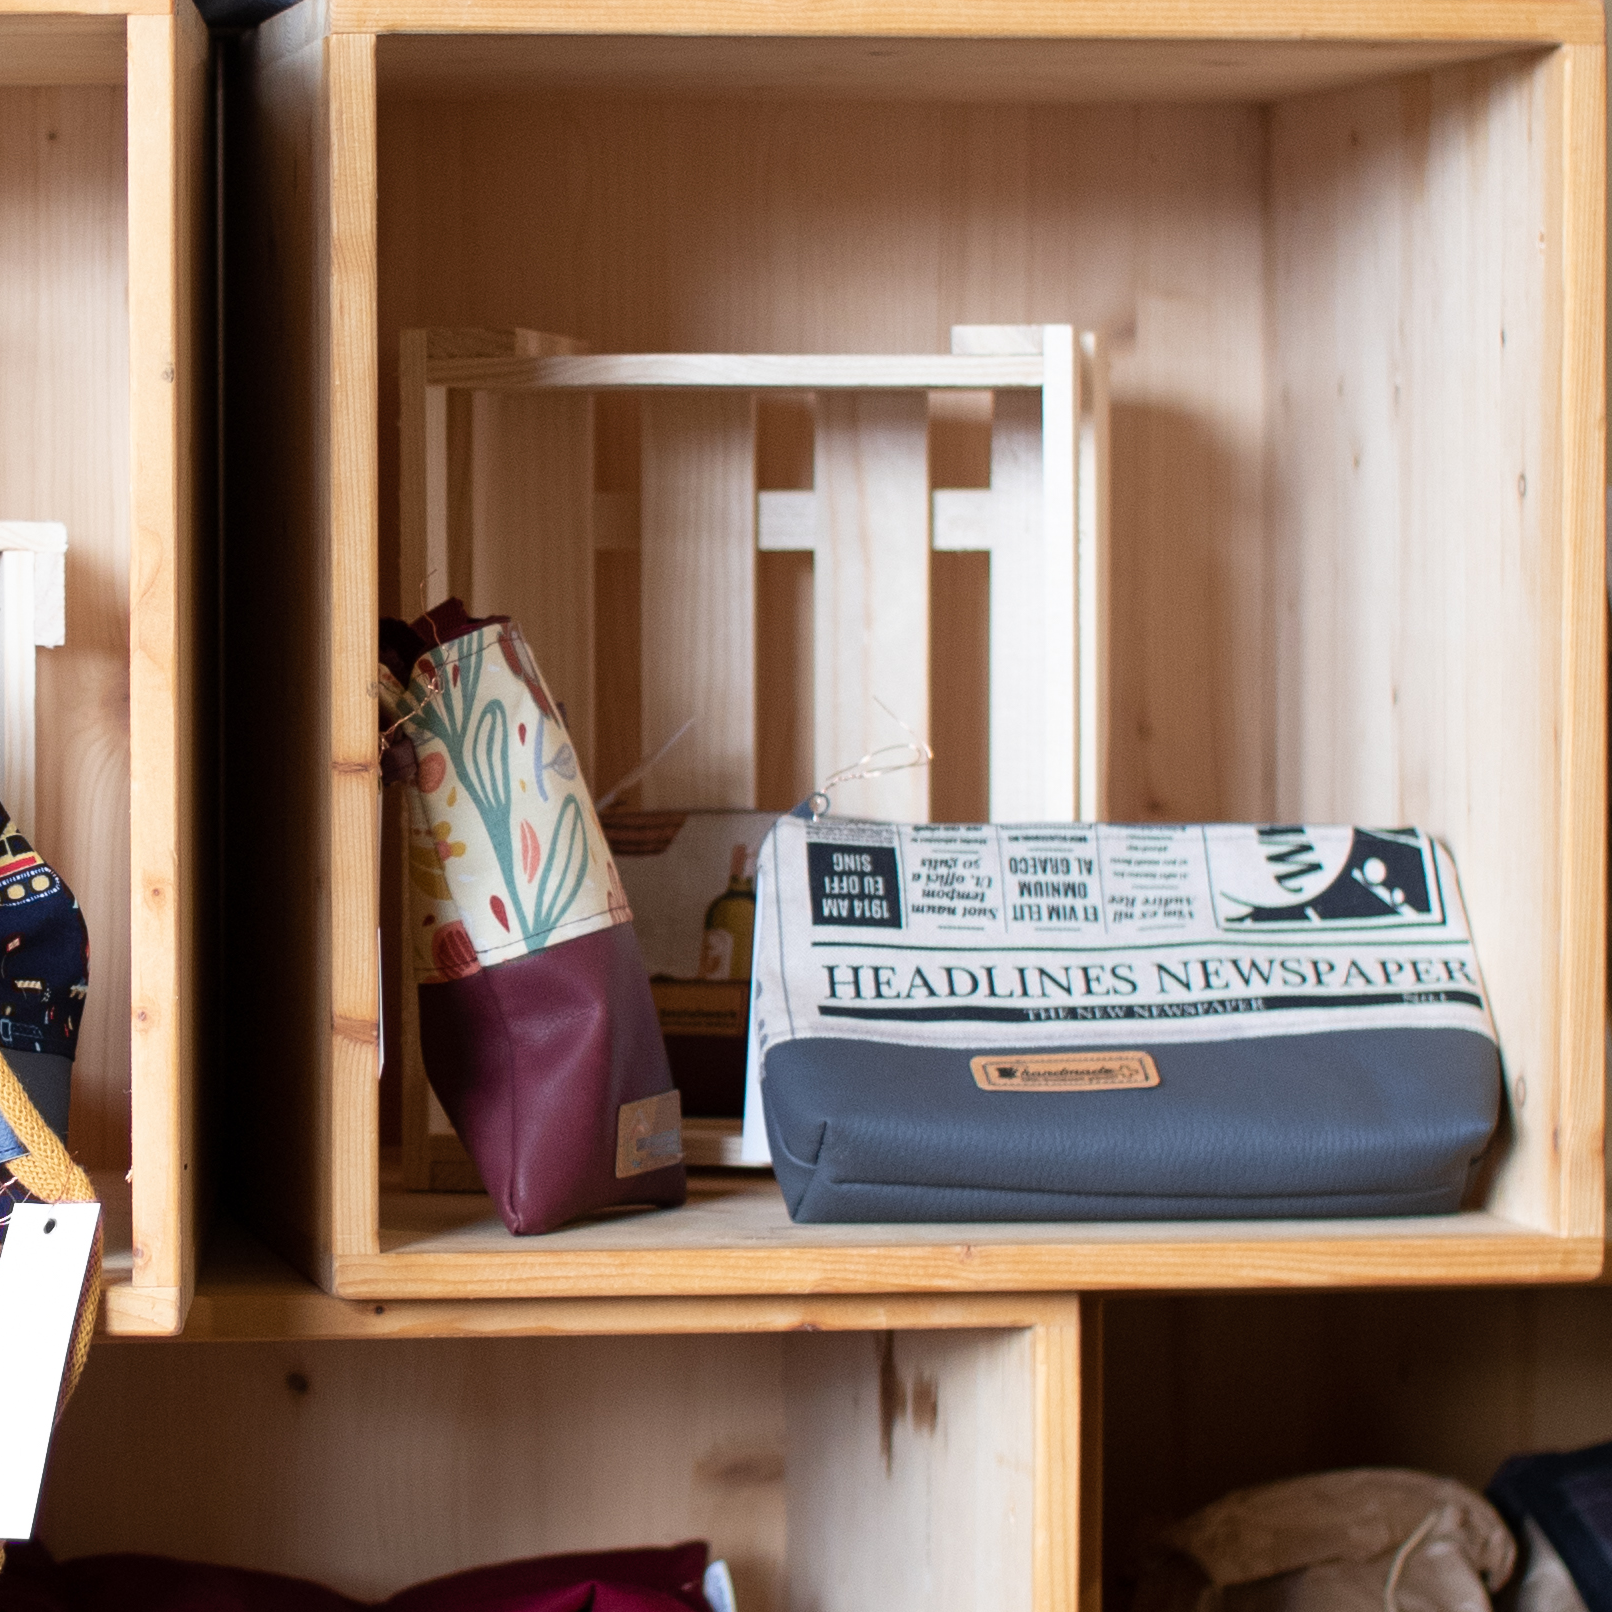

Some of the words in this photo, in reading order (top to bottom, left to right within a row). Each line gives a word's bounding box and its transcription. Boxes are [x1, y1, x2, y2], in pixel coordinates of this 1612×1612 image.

[832, 852, 872, 872] SING
[1008, 857, 1070, 875] GRAECO
[1076, 858, 1092, 875] AL
[823, 875, 859, 894] OFFI
[863, 875, 884, 895] EU
[1018, 880, 1087, 899] OMNIUM
[822, 897, 849, 918] AM
[852, 897, 889, 919] 1914
[1012, 904, 1042, 921] ELIT
[1046, 904, 1078, 921] VIM
[1083, 905, 1098, 922] ET
[822, 961, 1138, 1000] HEADLINES
[1156, 956, 1476, 992] NEWSPAPER
[1024, 1006, 1072, 1021] THE
[1077, 1005, 1127, 1020] NEW
[1133, 998, 1265, 1019] NEWSPAPER
